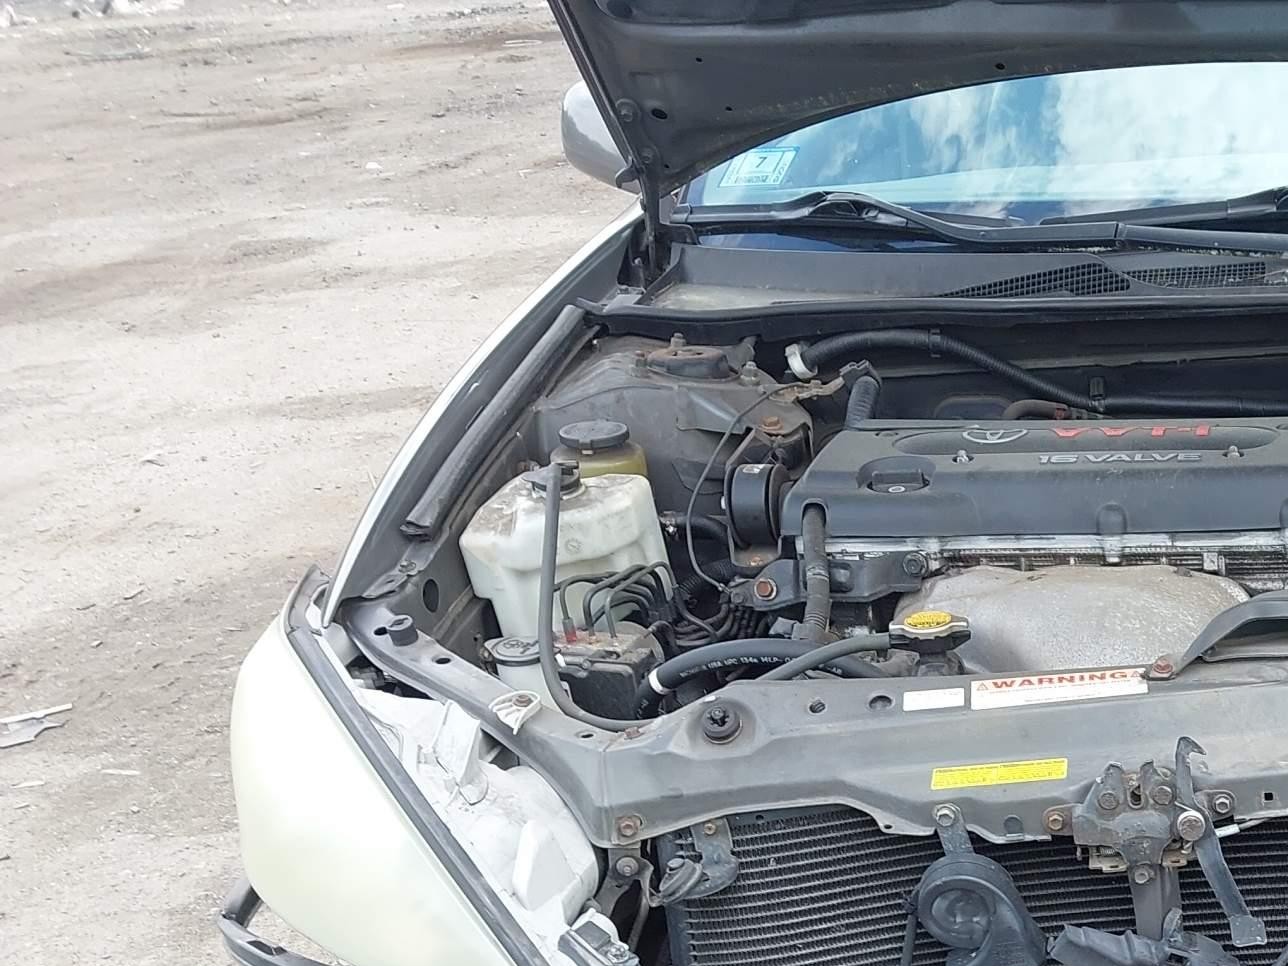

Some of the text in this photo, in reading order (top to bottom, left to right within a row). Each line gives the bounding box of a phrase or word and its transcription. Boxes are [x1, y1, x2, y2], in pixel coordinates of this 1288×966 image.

[1039, 452, 1202, 465] 16 VALVE
[991, 671, 1128, 689] WARNING
